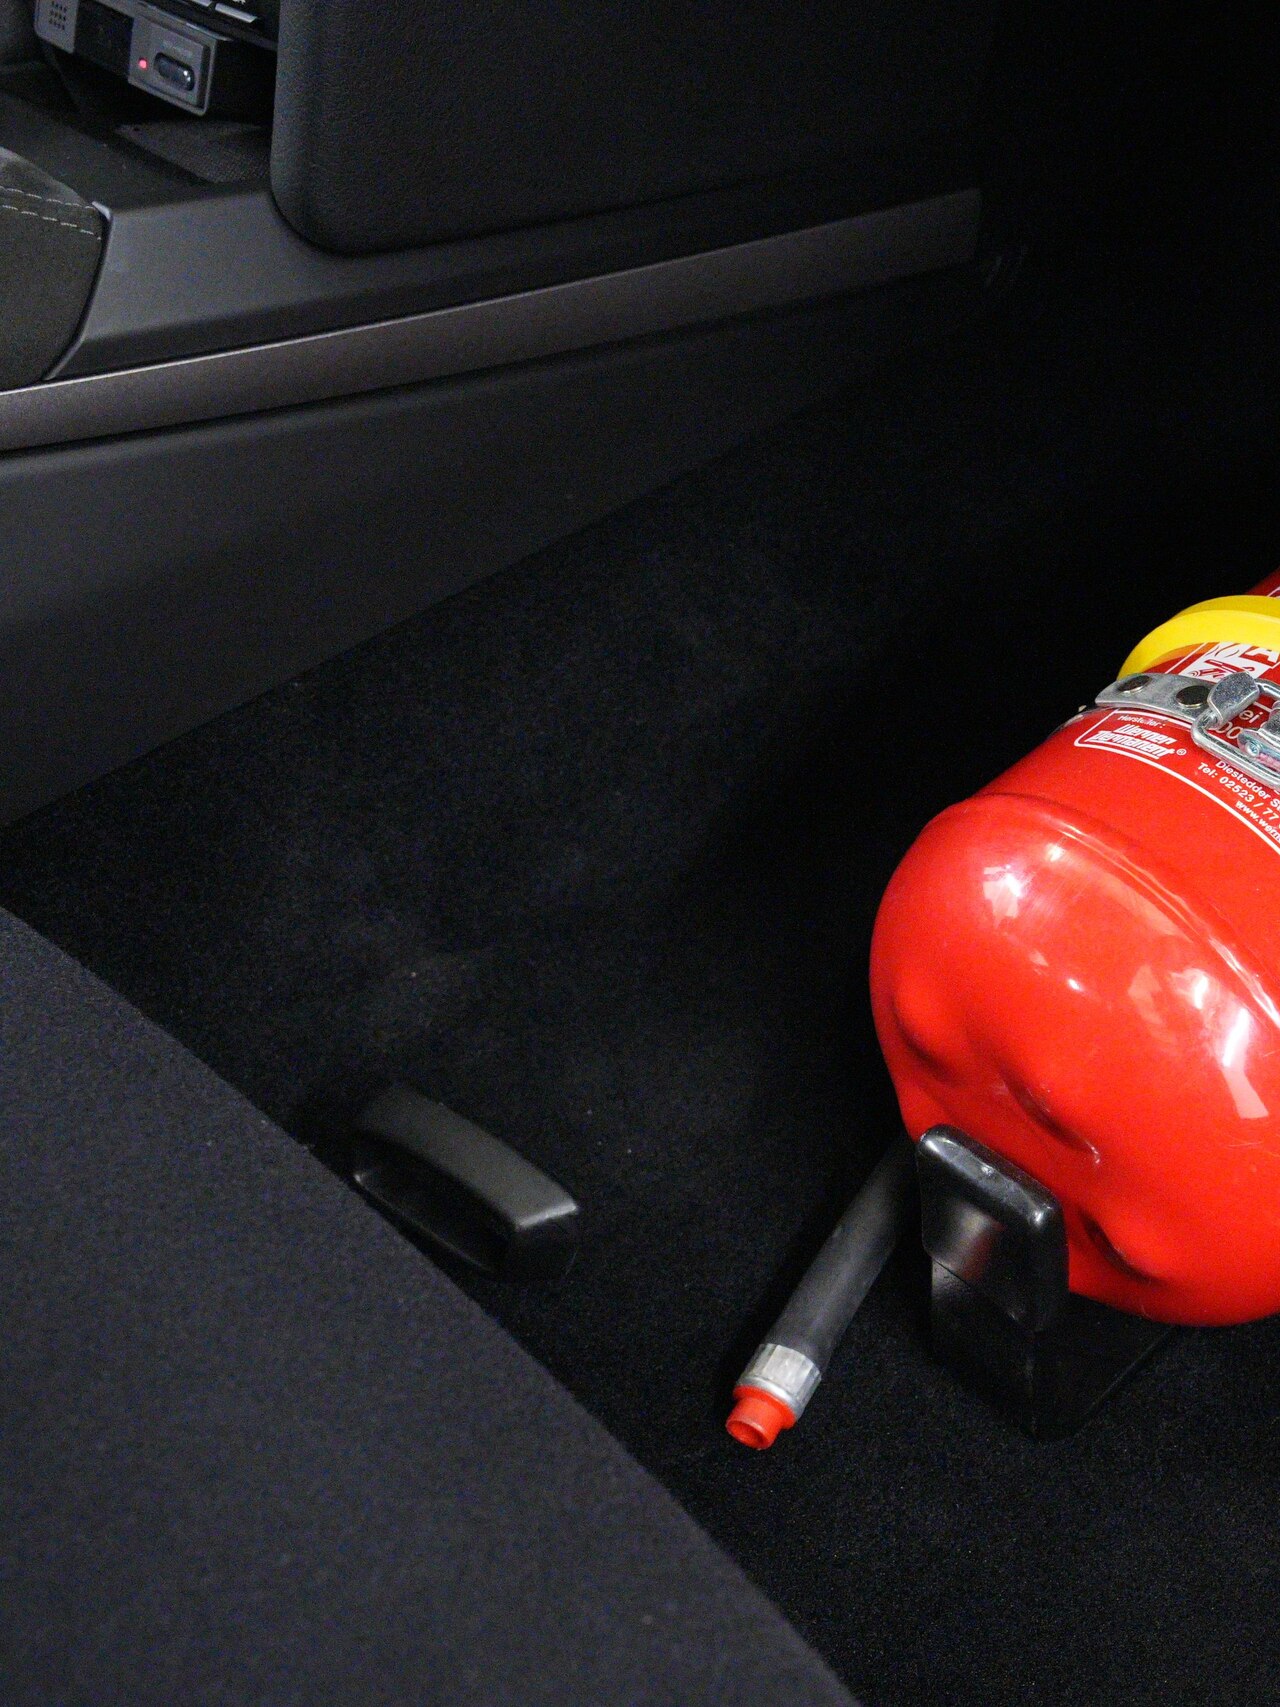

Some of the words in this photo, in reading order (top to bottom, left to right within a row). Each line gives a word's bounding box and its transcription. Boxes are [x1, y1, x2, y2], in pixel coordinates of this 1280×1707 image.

[1197, 762, 1219, 779] Tel:
[1219, 776, 1255, 804] 02523
[1262, 807, 1279, 821] 77
[1215, 760, 1271, 804] Diestedder
